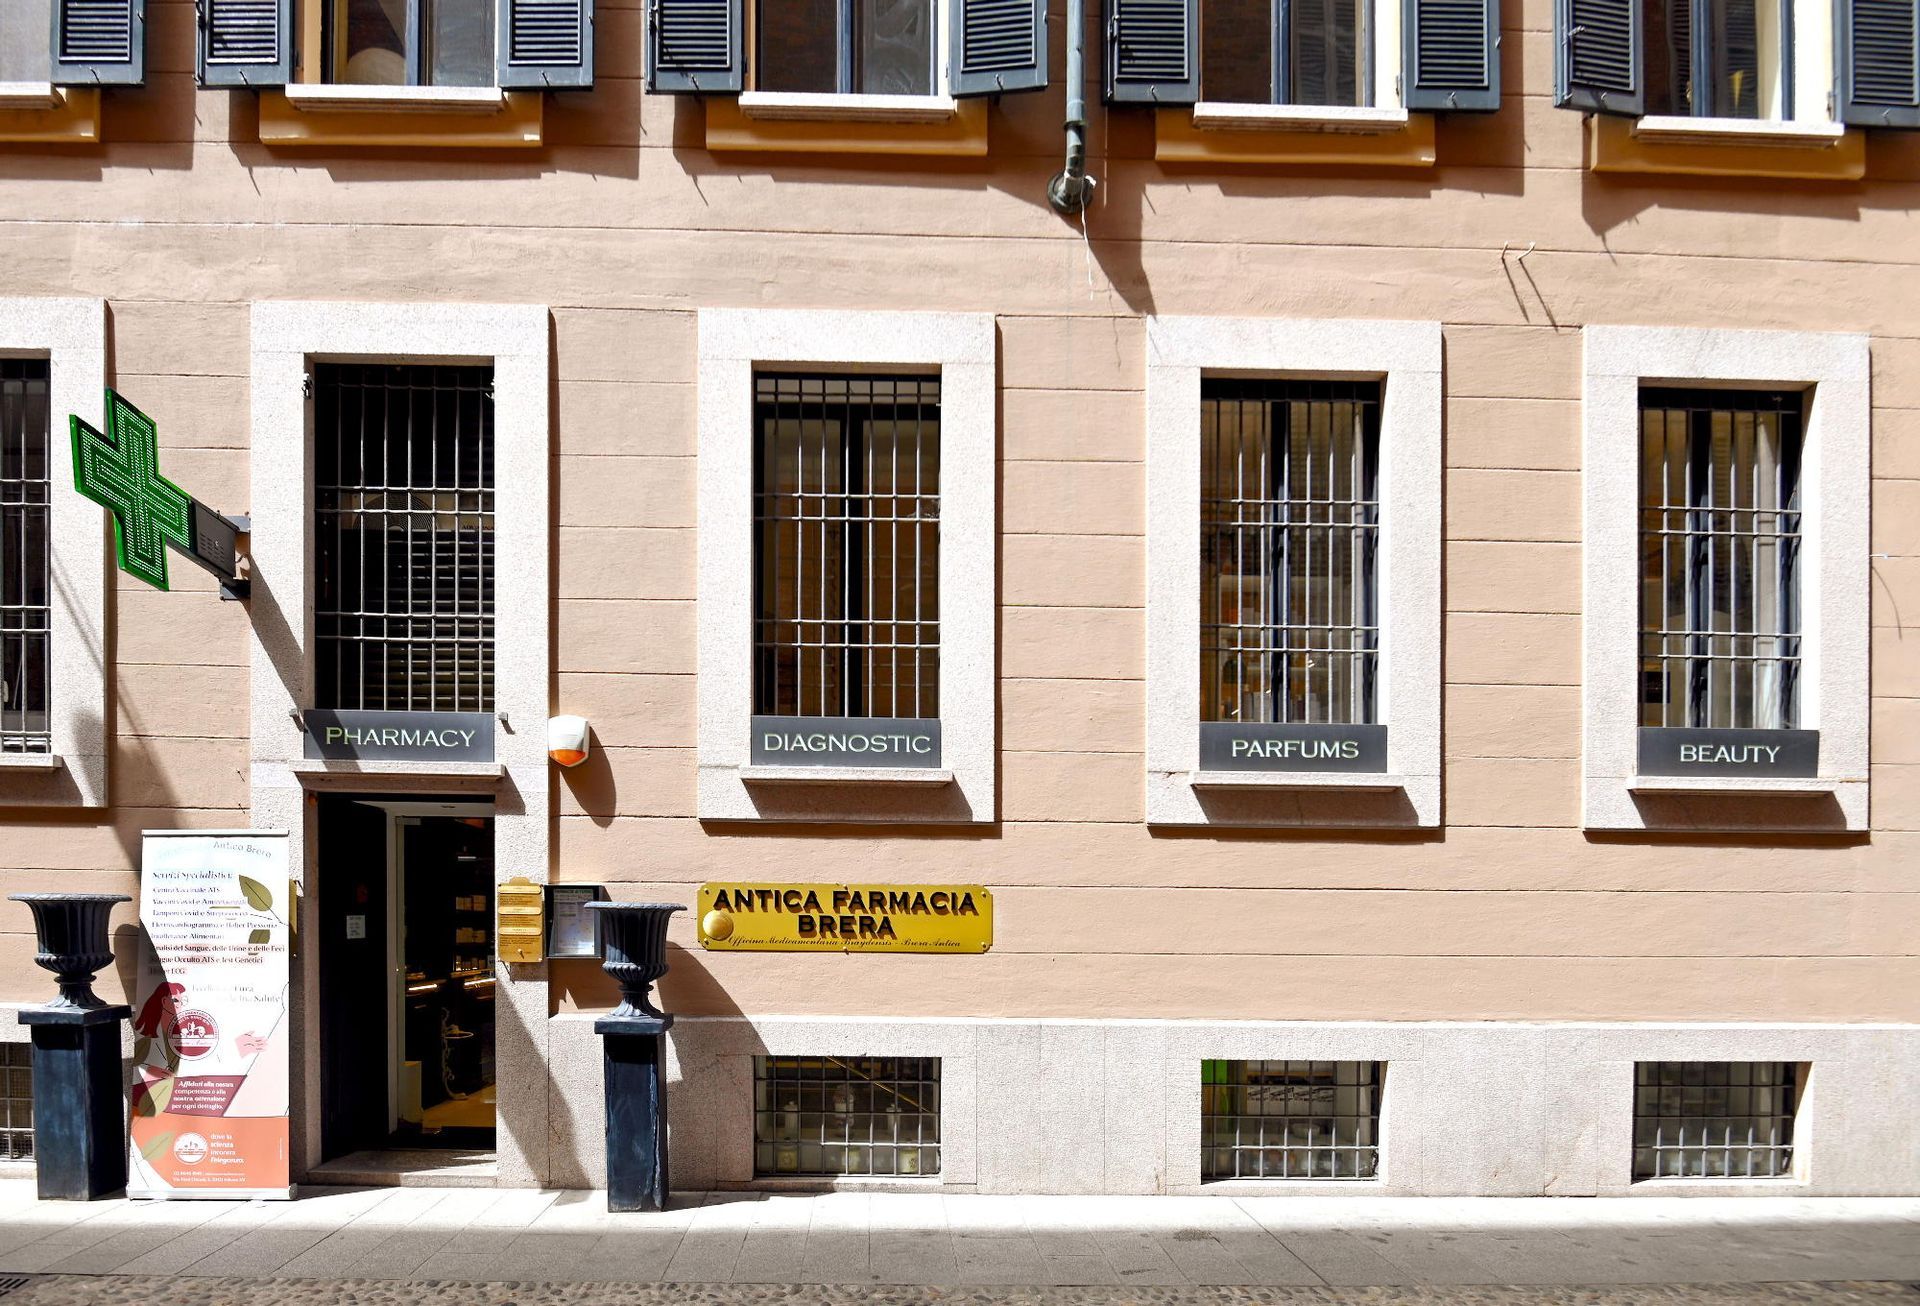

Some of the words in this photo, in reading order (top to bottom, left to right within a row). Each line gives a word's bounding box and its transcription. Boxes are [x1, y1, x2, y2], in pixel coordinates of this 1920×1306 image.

[325, 727, 476, 747] PHARMACY
[764, 733, 931, 754] DIAGNOSTIC
[1231, 739, 1360, 759] PARFUMS
[1679, 744, 1781, 764] BEAUTY
[713, 888, 824, 914] ANTICA
[832, 890, 980, 917] FARMACIA
[798, 914, 897, 940] BRERA
[728, 936, 764, 947] Officina
